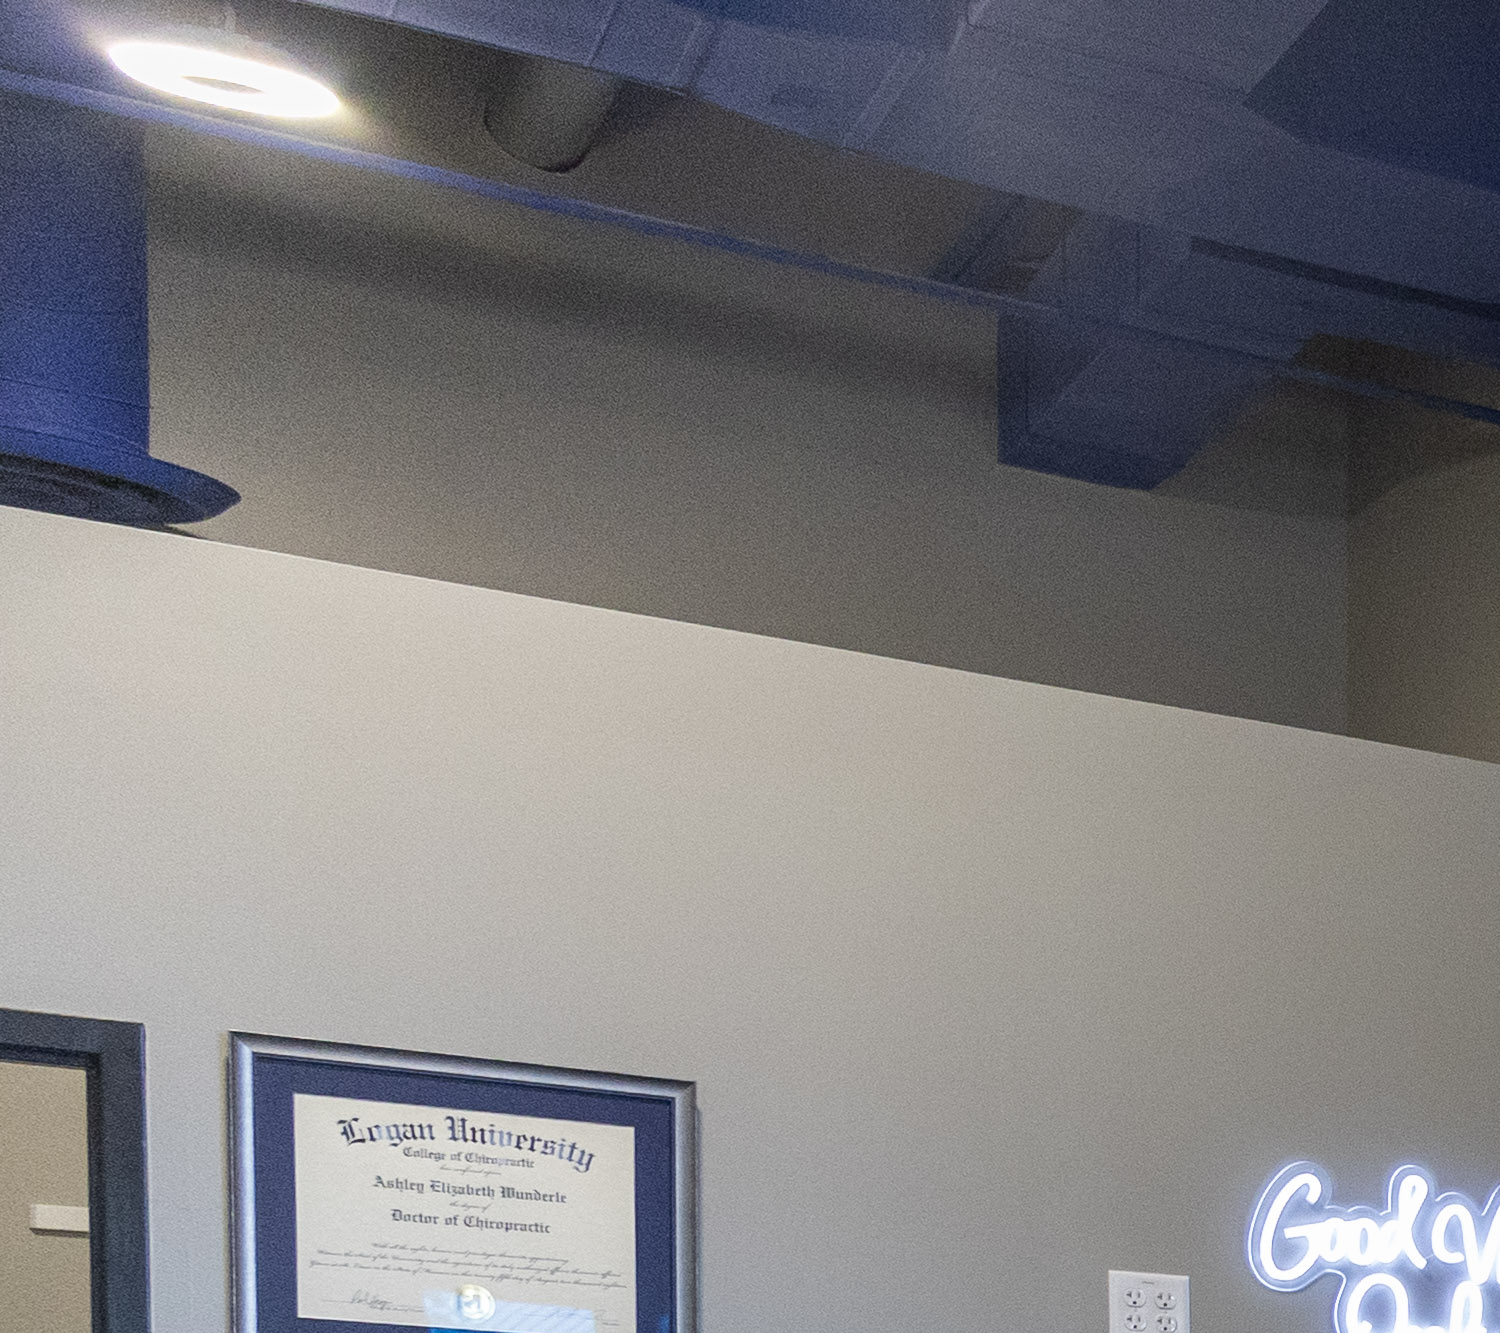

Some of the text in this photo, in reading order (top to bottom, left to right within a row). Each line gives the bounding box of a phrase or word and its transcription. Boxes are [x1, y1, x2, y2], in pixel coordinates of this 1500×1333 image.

[337, 1116, 596, 1173] Logan University
[402, 1147, 535, 1169] College of Chiropractic
[373, 1175, 567, 1204] Ashley Elizabeth Wunderle
[391, 1209, 552, 1234] Doctor of Chiropractic
[1260, 1172, 1428, 1281] Good
